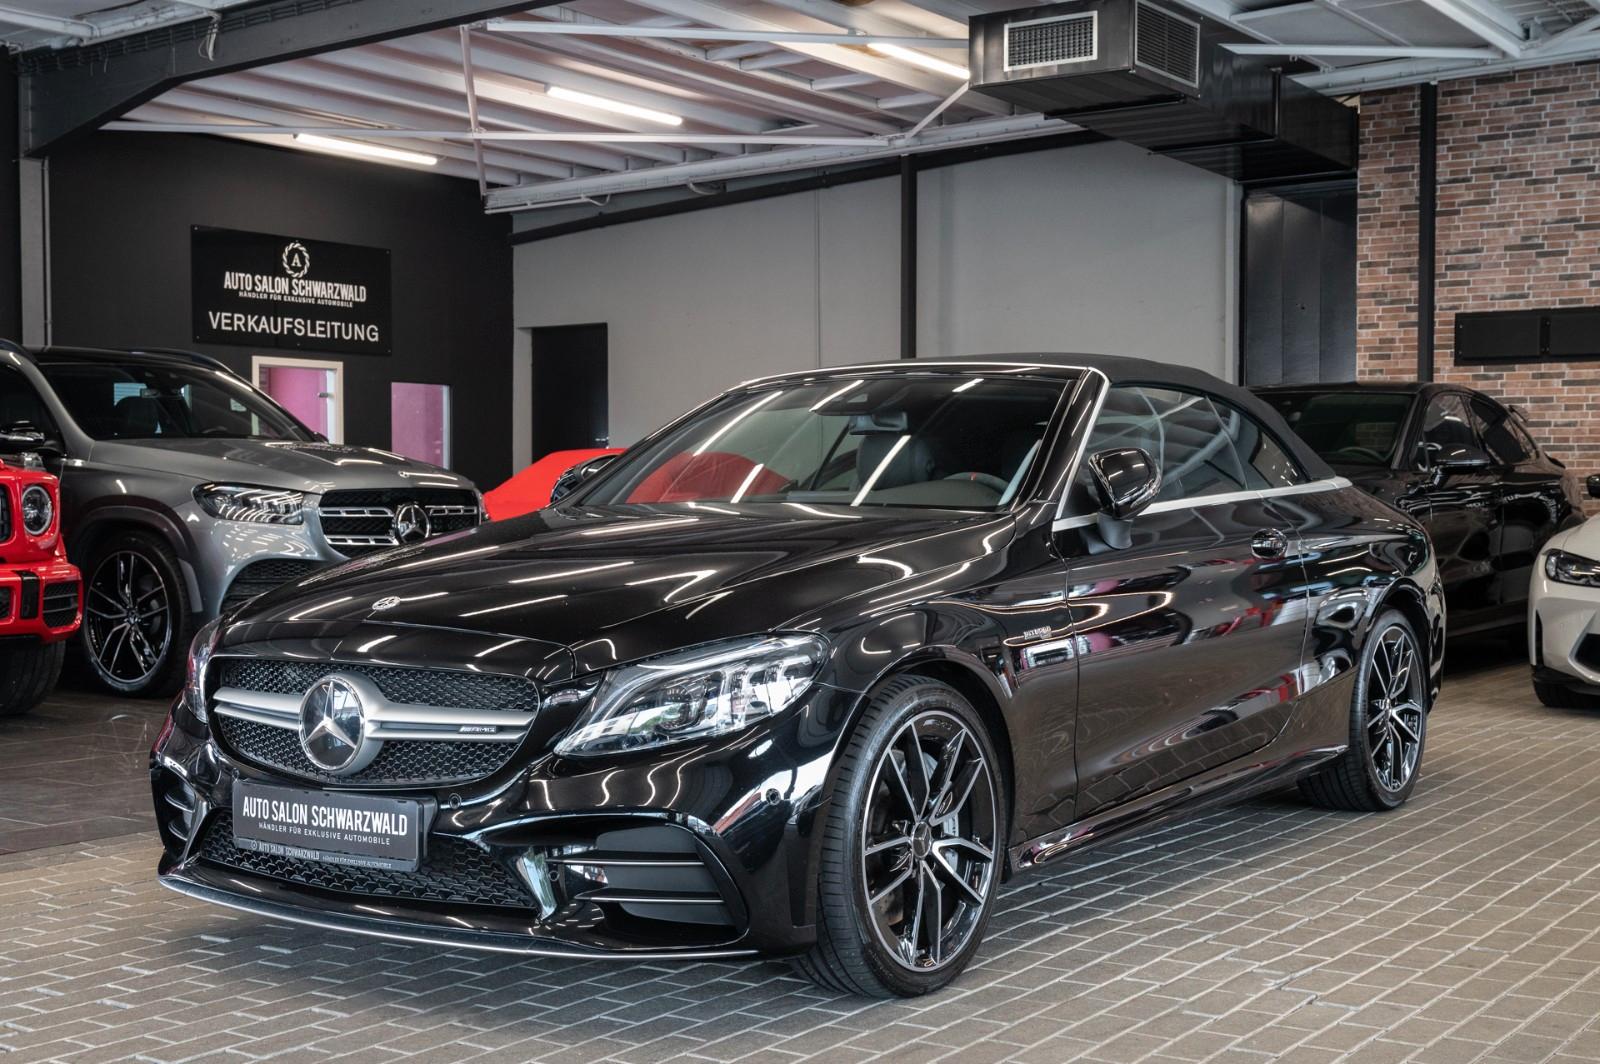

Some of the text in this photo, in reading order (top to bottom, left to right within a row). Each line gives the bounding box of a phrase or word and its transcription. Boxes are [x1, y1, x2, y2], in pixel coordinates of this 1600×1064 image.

[291, 252, 303, 268] A
[224, 271, 367, 302] AUTO SALON SCHWARZWALD
[238, 290, 353, 308] HÄNDLER FÜR EXKLUSIVE AUTOMOBILE
[208, 311, 379, 342] VERKAUFSLEITUNG
[243, 796, 408, 836] AUTO SALON SCHWARZWALD
[258, 822, 391, 846] HÄNDLER FÜR EXKLUSIVE AUTOMOBILE
